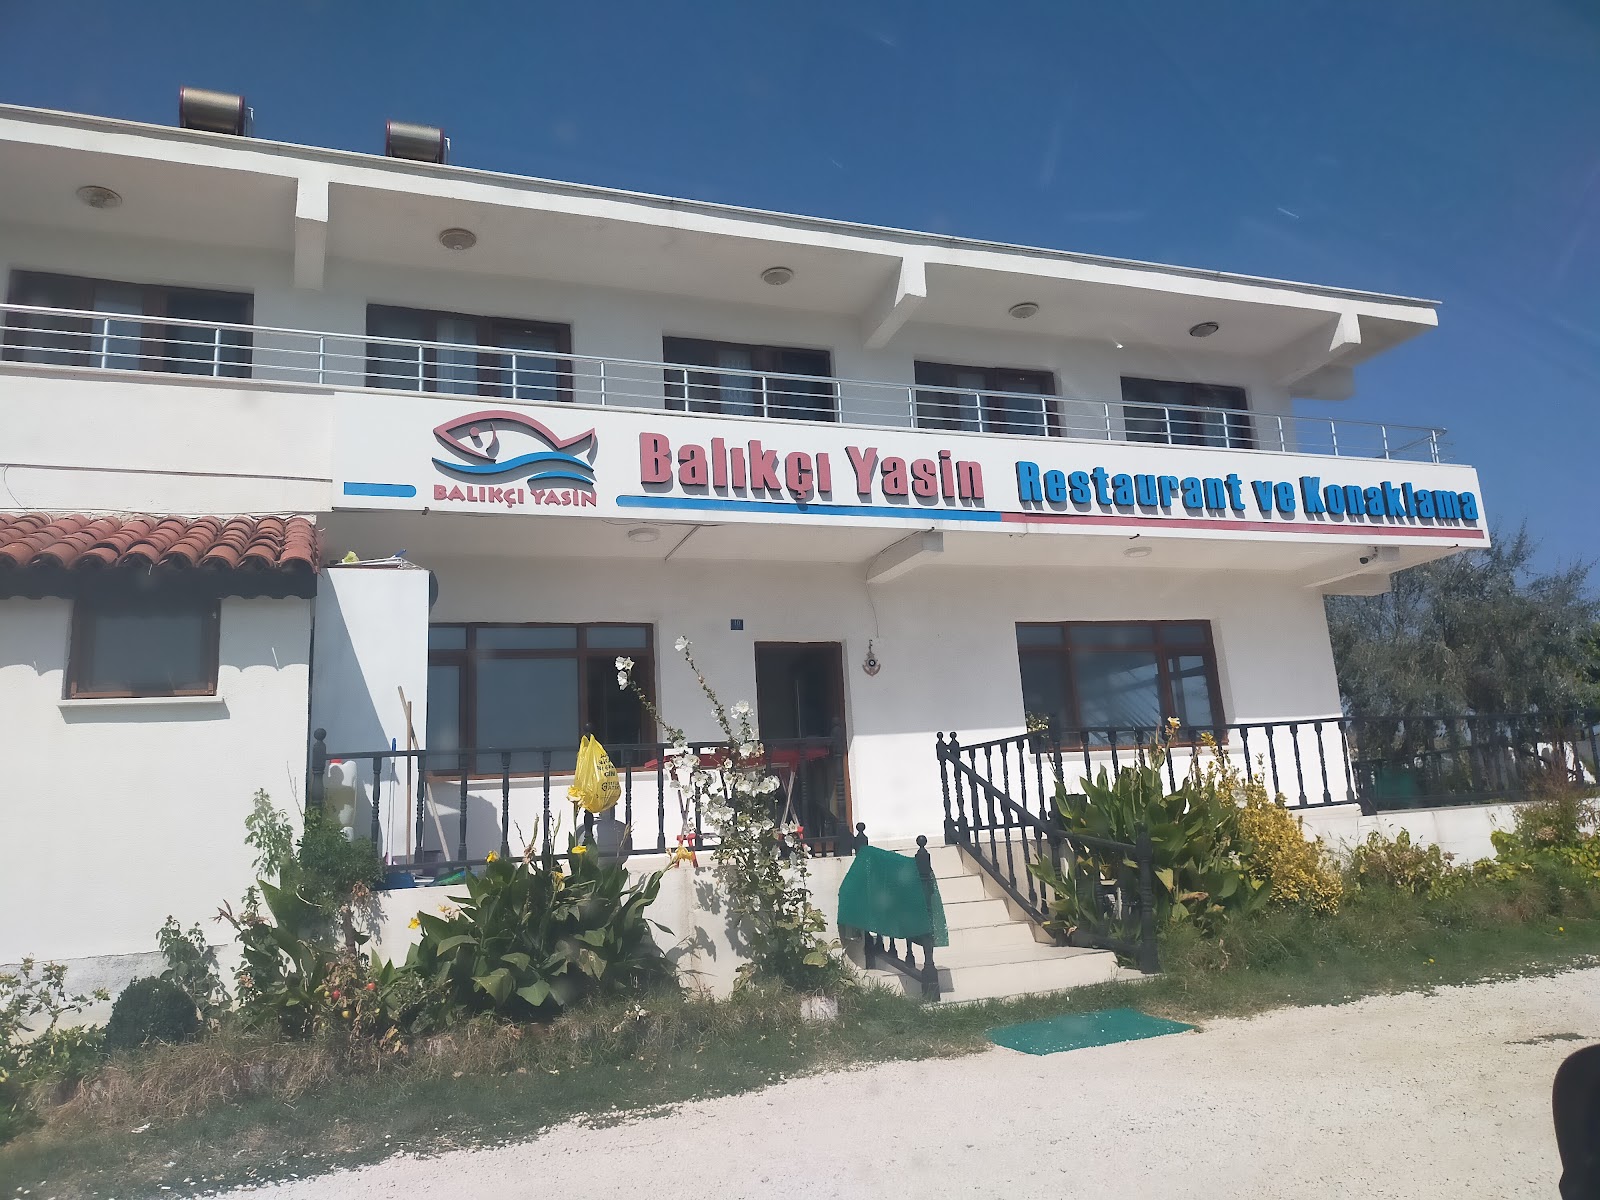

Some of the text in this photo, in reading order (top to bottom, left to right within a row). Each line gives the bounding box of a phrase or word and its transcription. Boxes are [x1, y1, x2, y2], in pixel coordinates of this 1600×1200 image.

[433, 484, 525, 508] BALIKÇI
[639, 432, 1479, 520] Balıkçı Yasin Restaurant ve Konaklama
